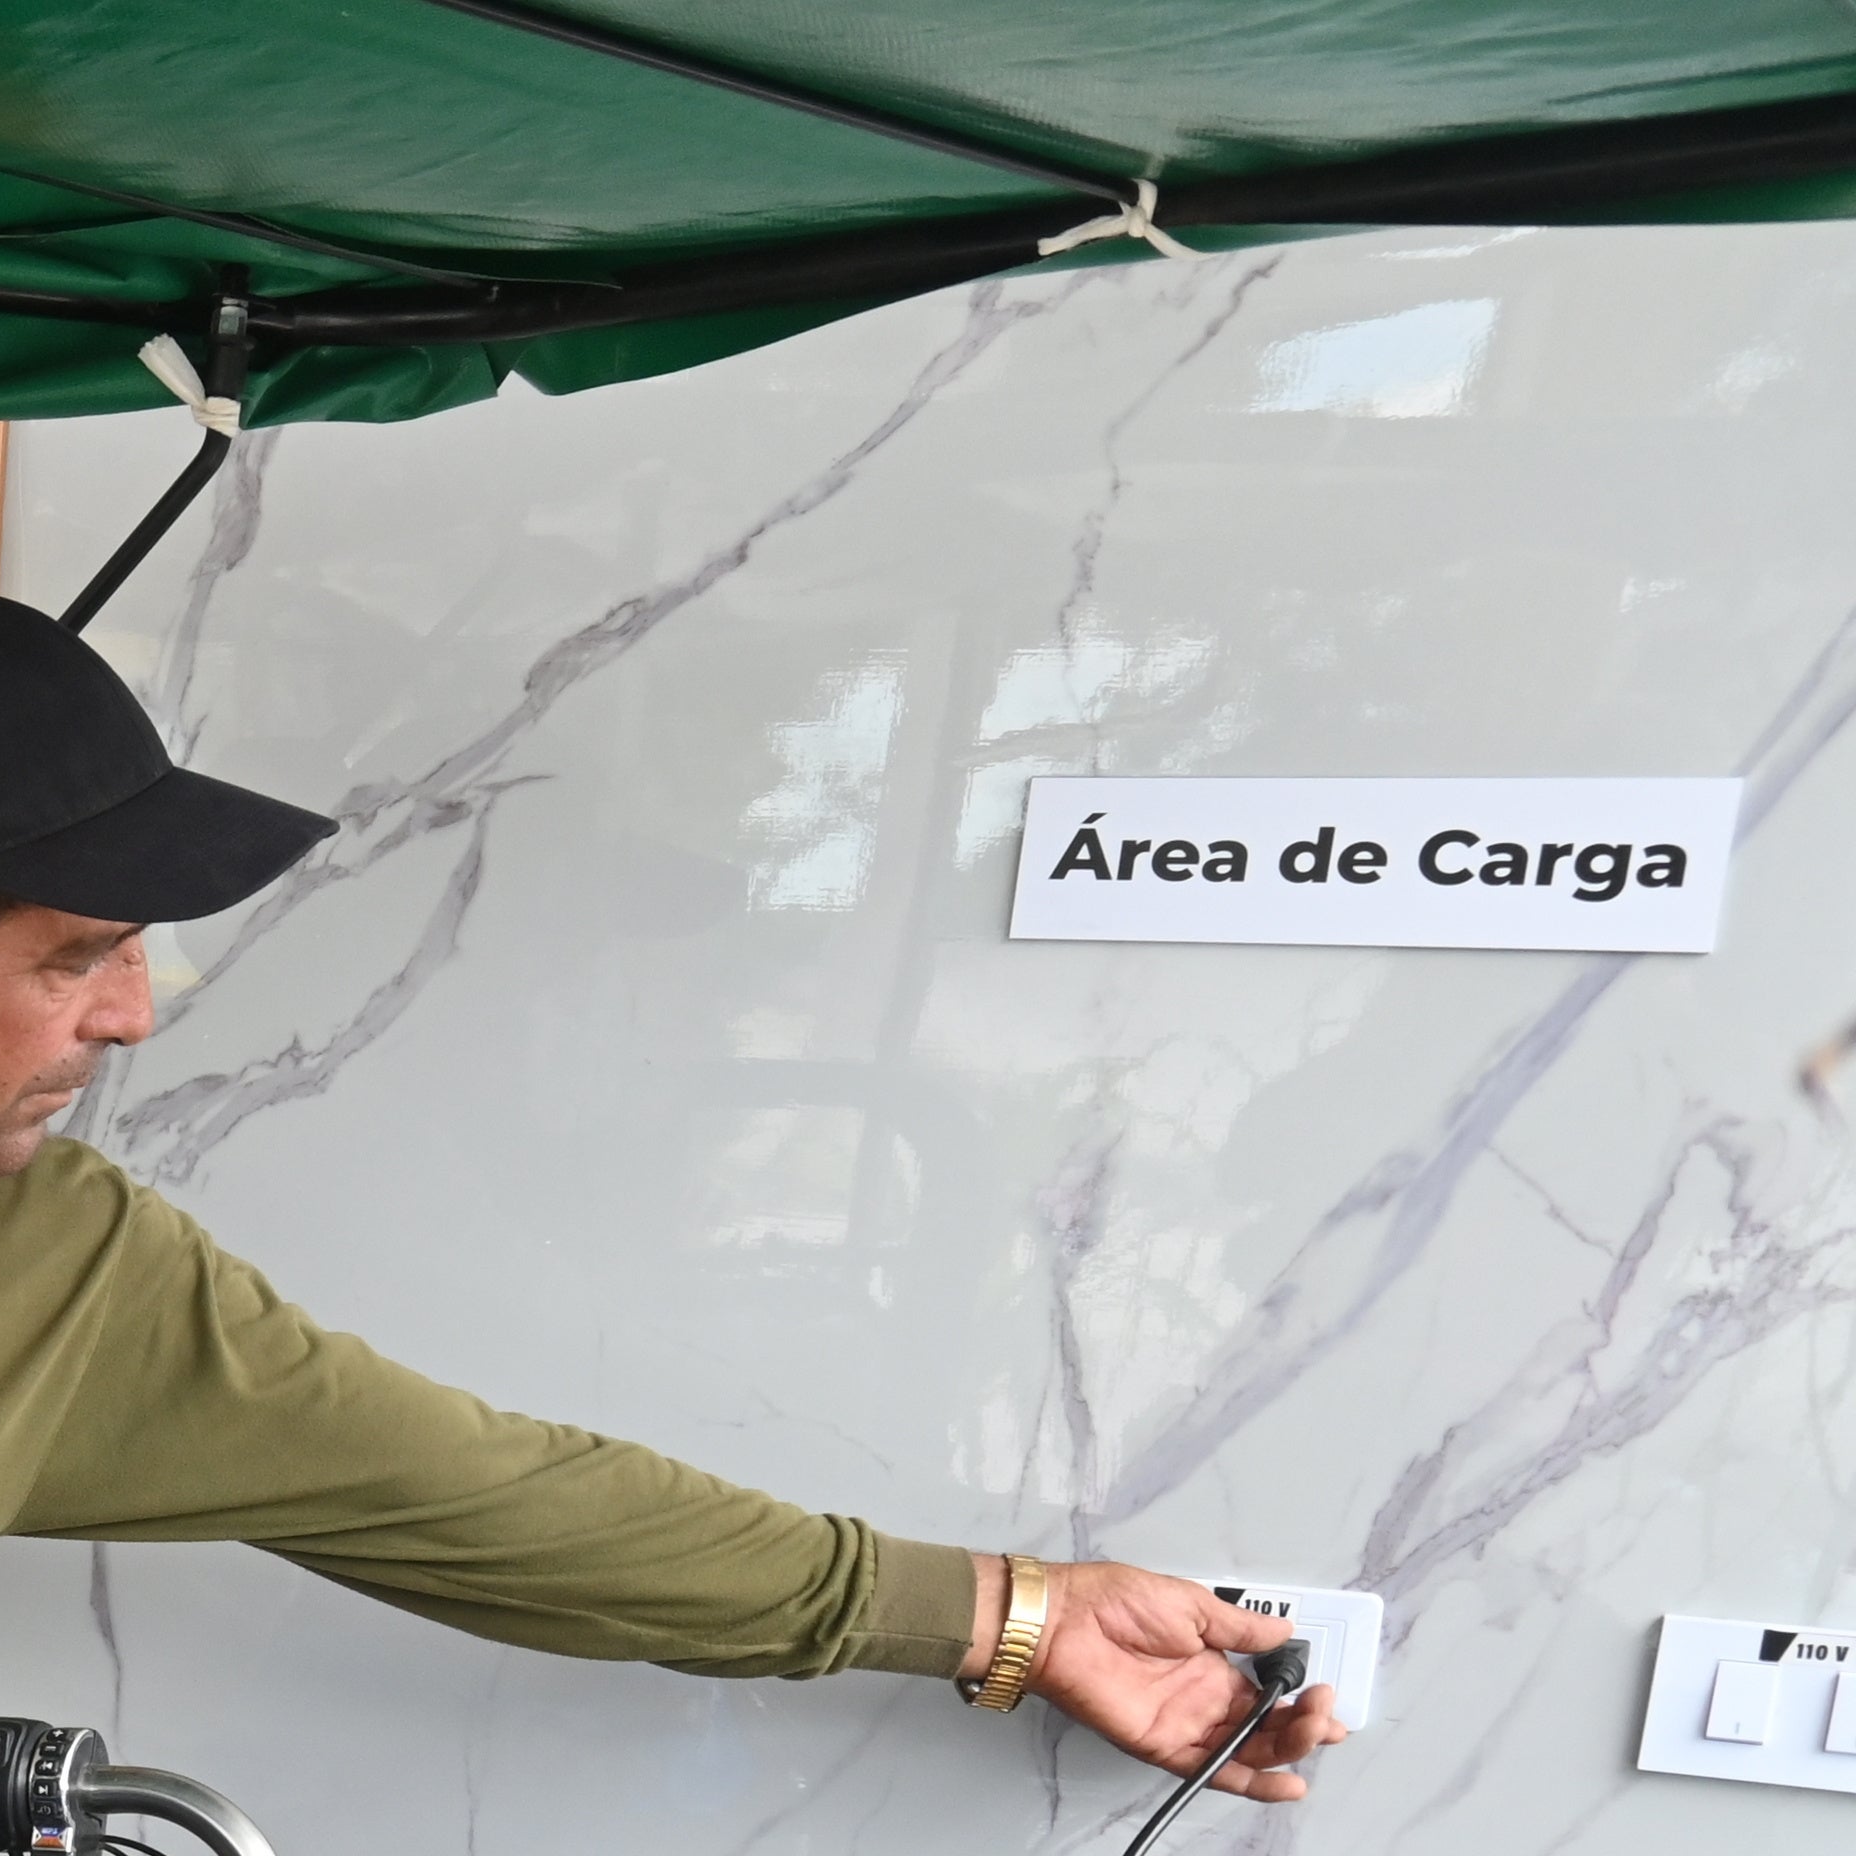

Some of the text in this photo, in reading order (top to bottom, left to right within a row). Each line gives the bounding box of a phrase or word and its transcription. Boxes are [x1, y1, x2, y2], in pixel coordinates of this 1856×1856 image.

[1048, 812, 1688, 903] Área de Carga
[1245, 1599, 1291, 1618] 110 V
[1796, 1643, 1850, 1662] 110 V
